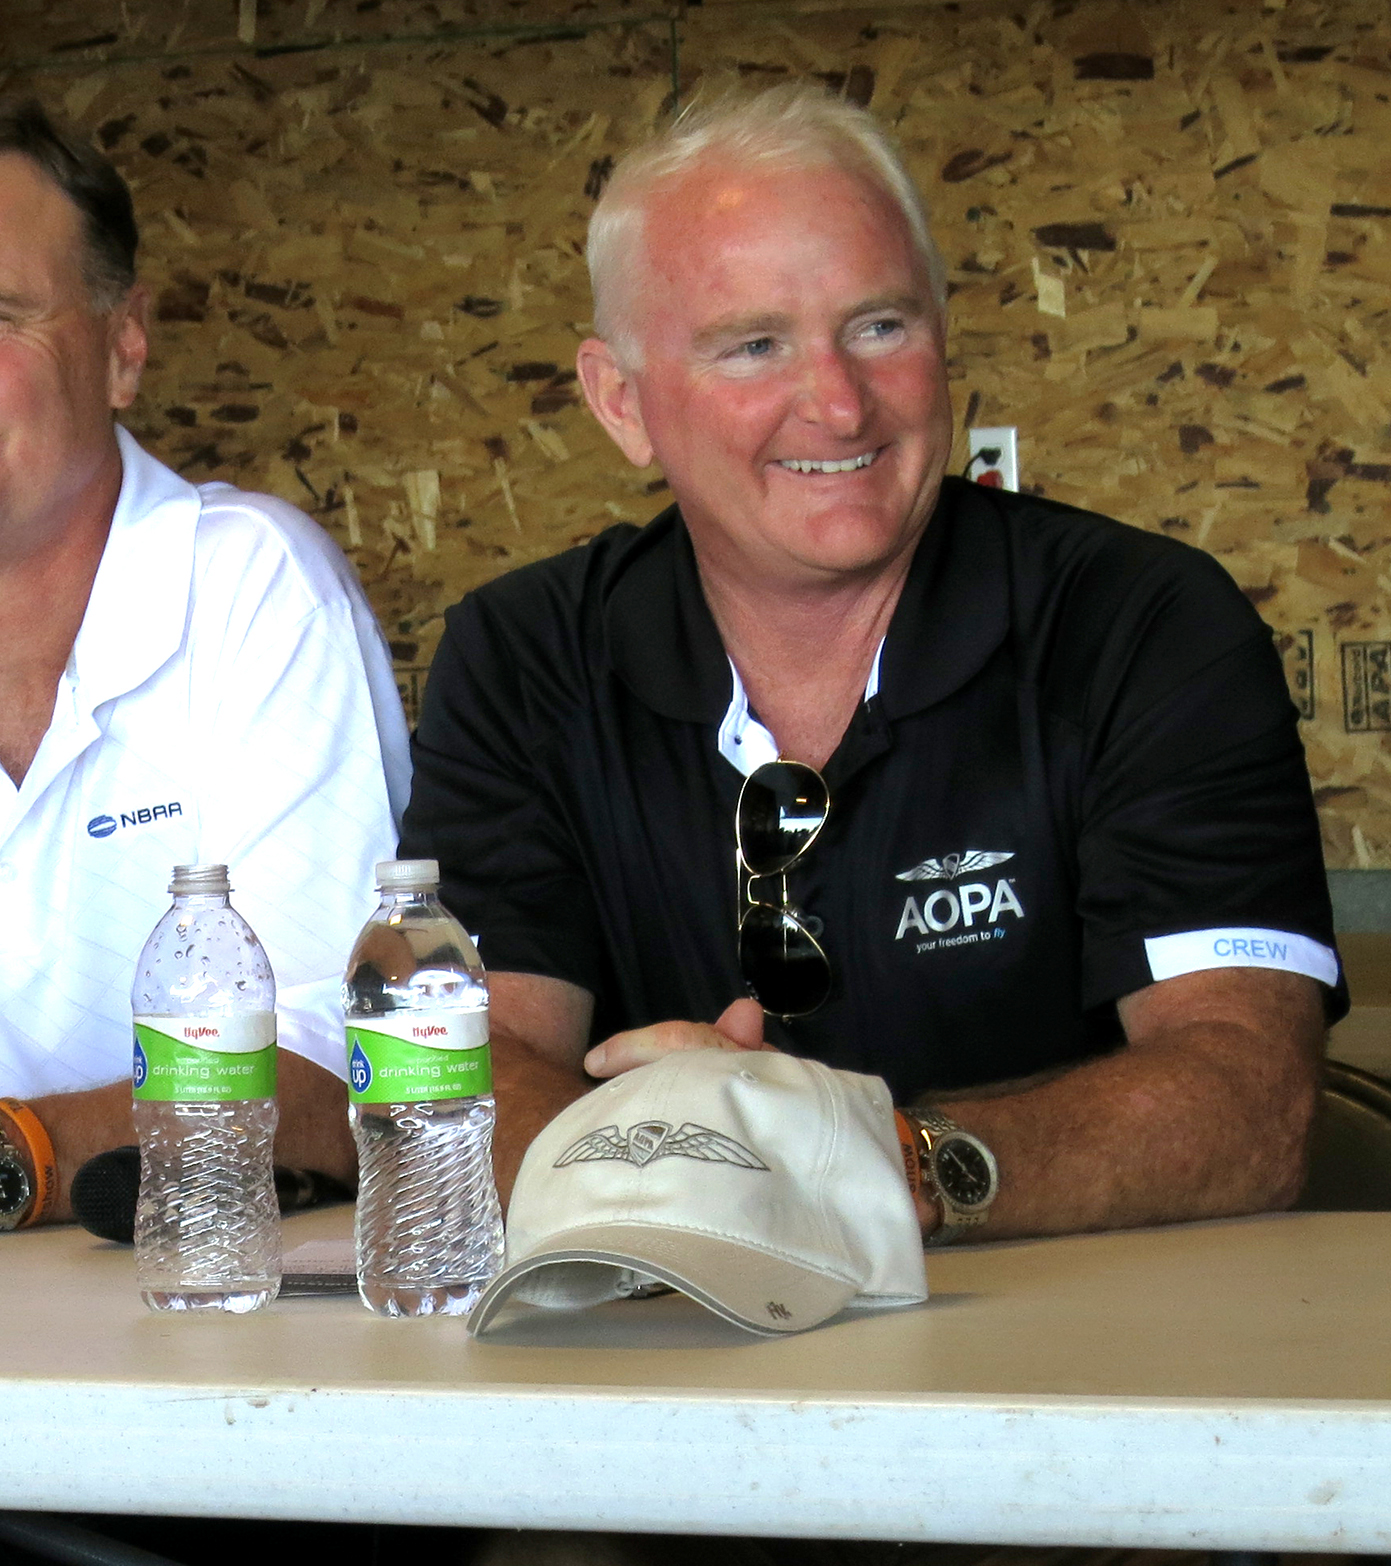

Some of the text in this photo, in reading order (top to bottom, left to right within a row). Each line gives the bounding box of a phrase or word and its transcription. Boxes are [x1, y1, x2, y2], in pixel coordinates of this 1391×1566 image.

[120, 801, 183, 828] NBAA
[894, 878, 1025, 940] AOPA
[916, 927, 1005, 954] your freedom to fly
[1213, 938, 1287, 961] CREW
[152, 1064, 255, 1079] drinking water
[352, 1069, 367, 1087] up
[379, 1061, 479, 1078] drinking water
